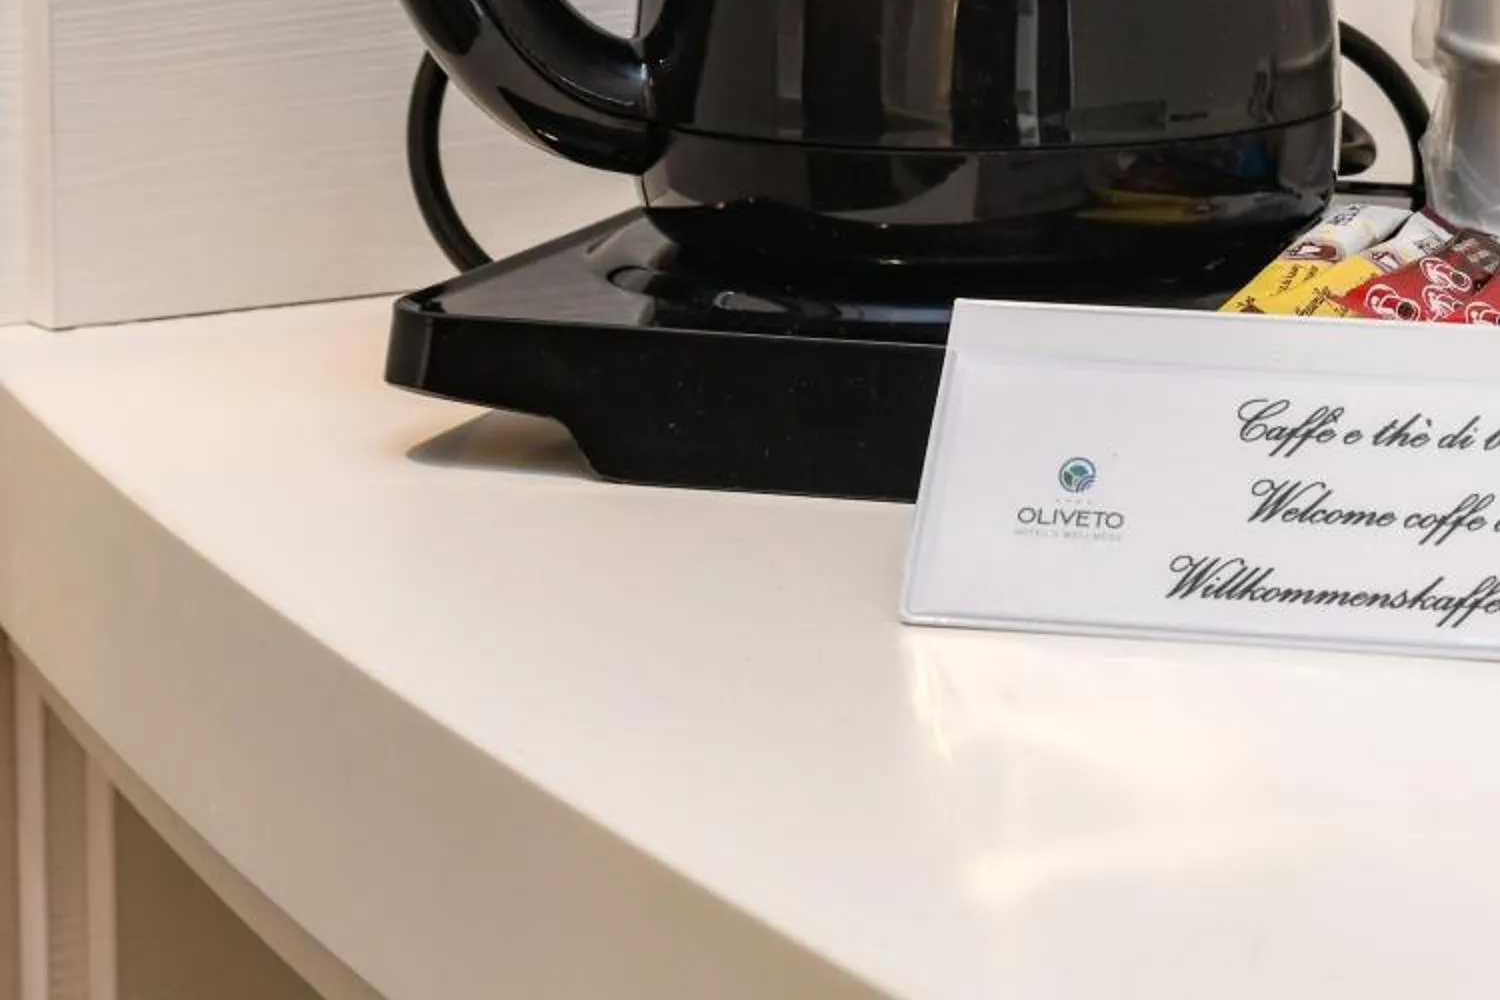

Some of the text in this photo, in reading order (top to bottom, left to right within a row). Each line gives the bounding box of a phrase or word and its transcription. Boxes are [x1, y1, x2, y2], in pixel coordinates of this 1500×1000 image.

[1342, 429, 1364, 446] e
[1371, 412, 1433, 449] thè
[1436, 415, 1481, 451] di
[1017, 506, 1125, 530] OLIVETO
[1247, 478, 1398, 528] Welcome
[1402, 492, 1496, 547] coffe
